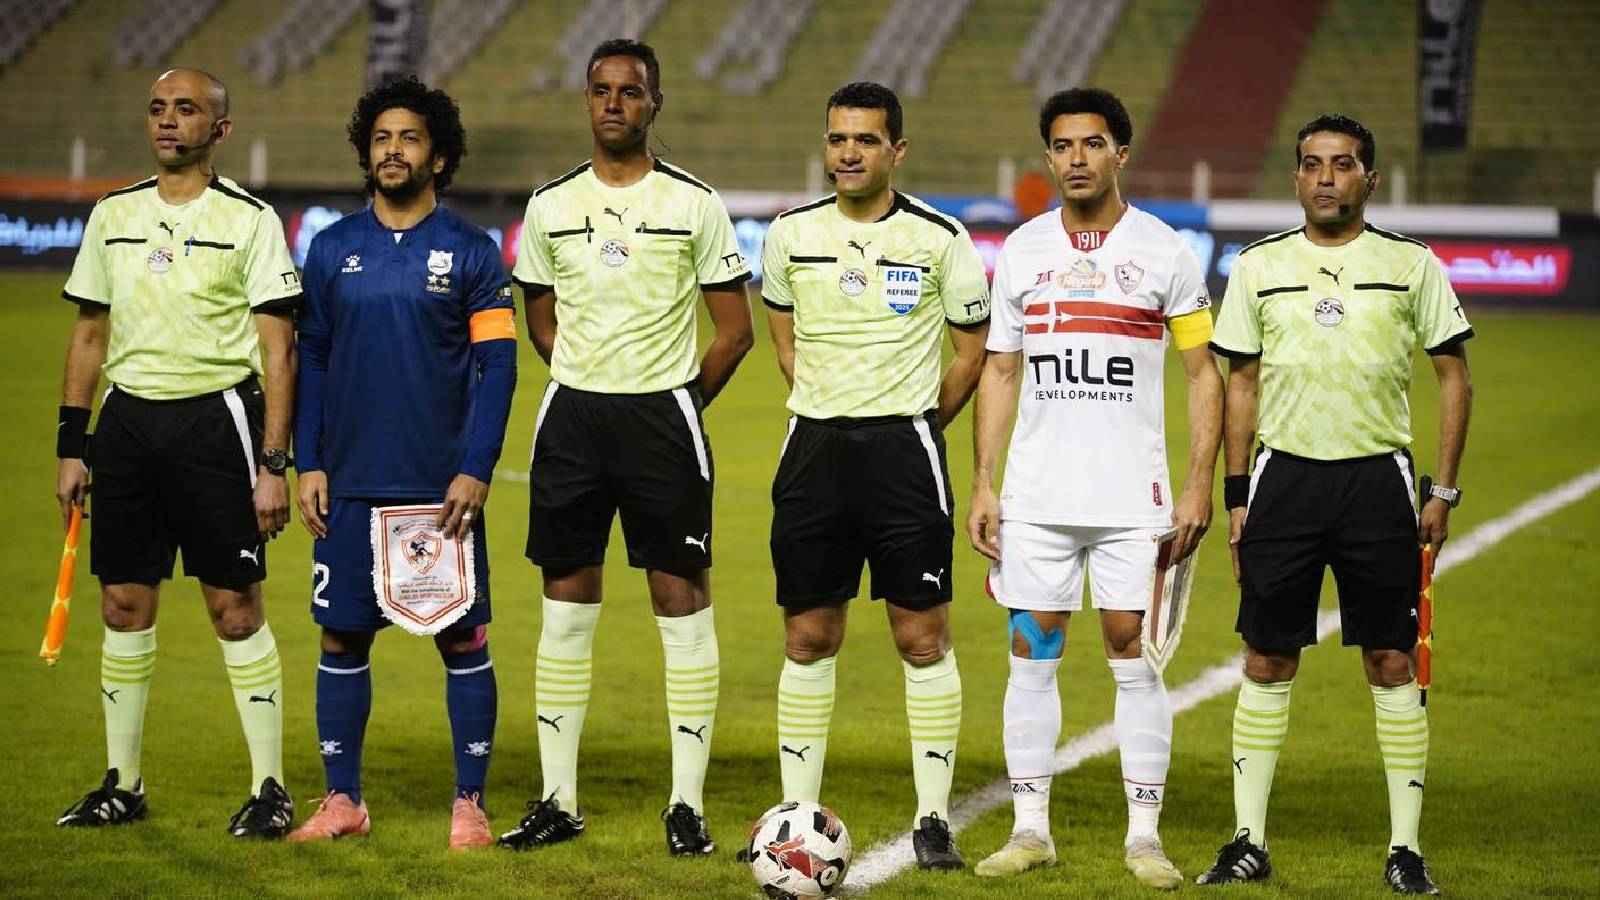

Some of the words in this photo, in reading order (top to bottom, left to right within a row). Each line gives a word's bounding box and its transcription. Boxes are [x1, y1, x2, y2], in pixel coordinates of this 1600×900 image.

[1077, 231, 1101, 249] 1911
[887, 270, 919, 282] FIFA
[887, 288, 919, 297] REFEREE
[1035, 389, 1134, 402] DEVELOPMENTS
